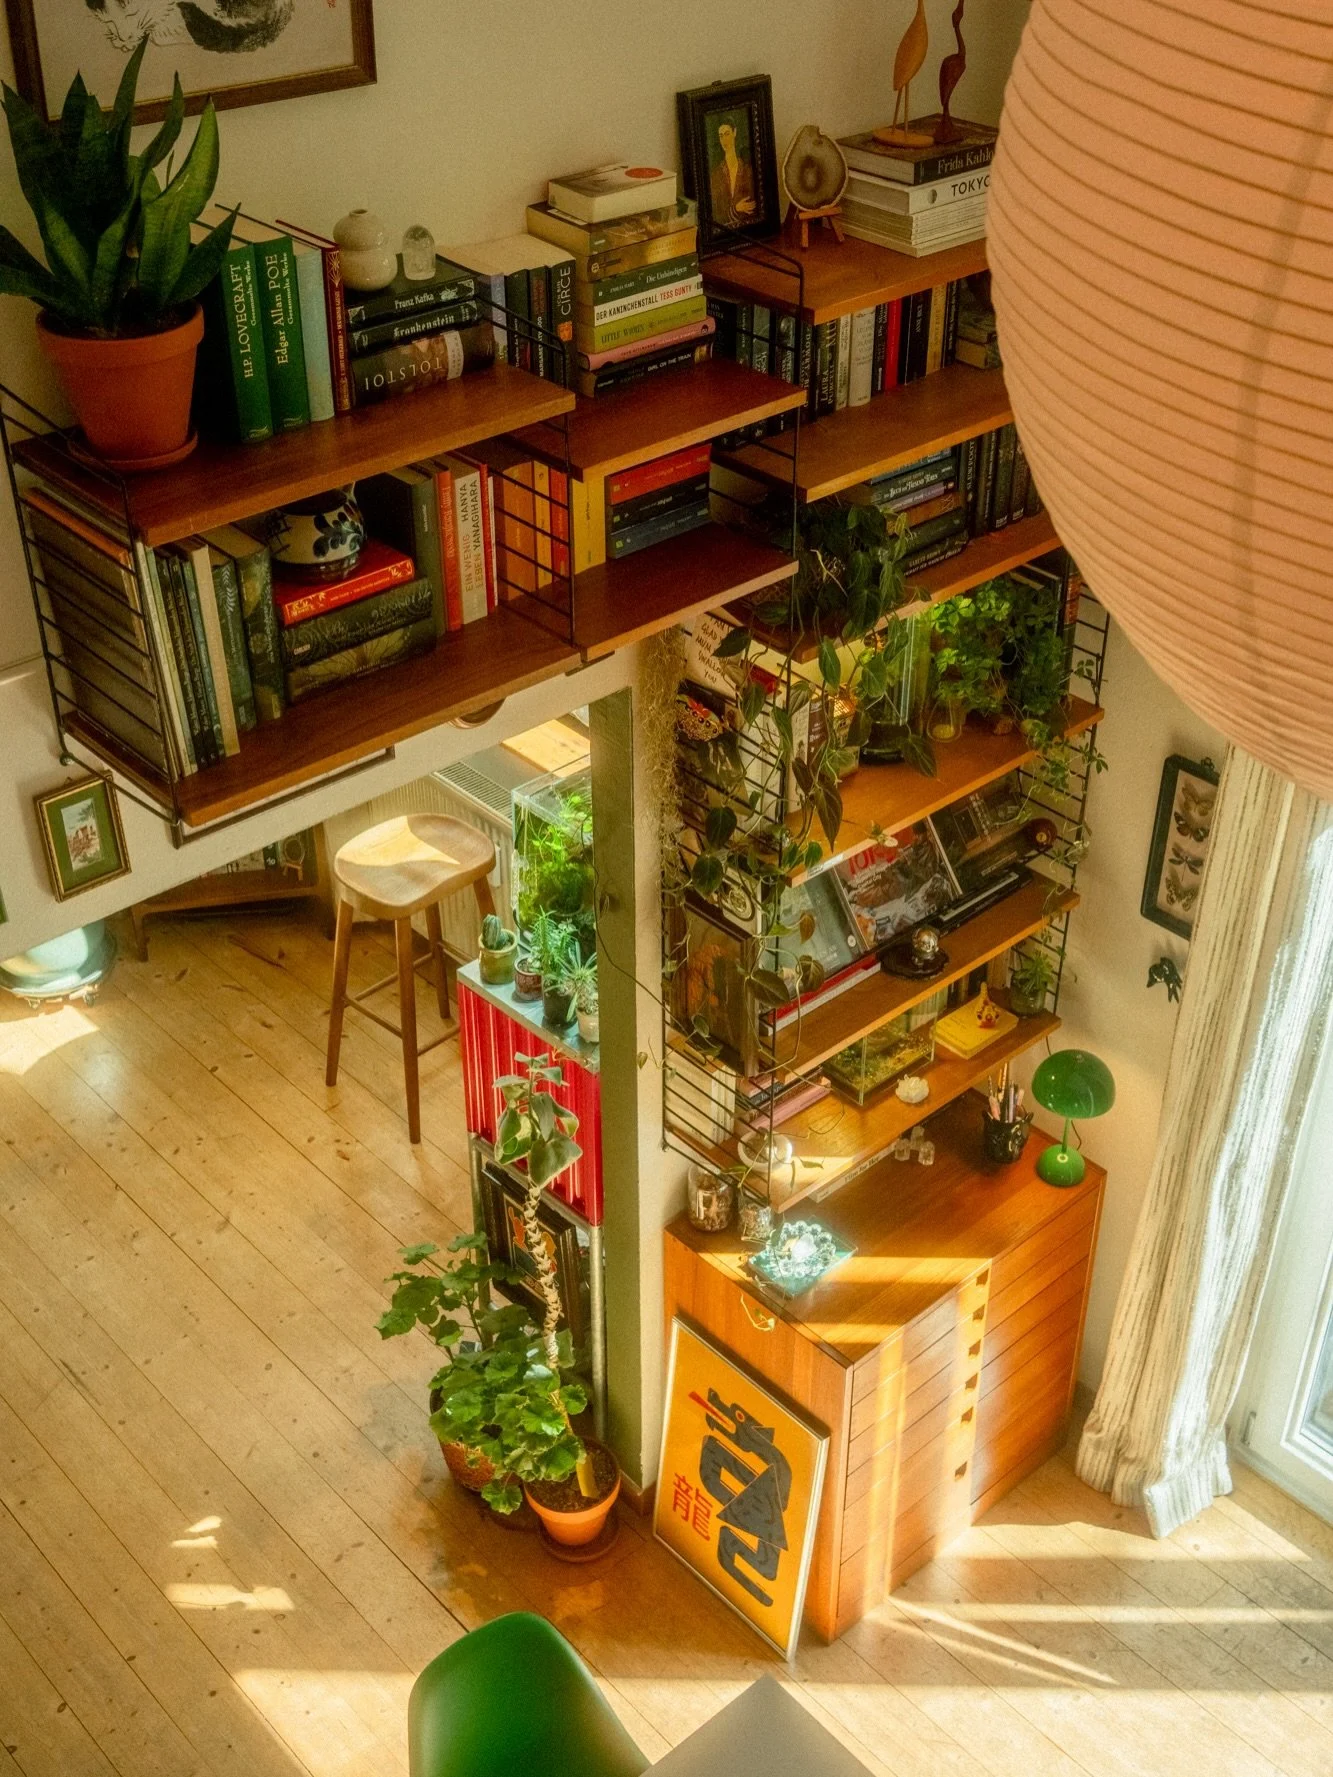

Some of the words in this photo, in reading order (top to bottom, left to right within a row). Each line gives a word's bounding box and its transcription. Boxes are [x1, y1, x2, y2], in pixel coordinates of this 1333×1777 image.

[938, 152, 964, 174] Frida
[266, 254, 280, 290] POE
[646, 273, 656, 284] Die
[395, 296, 414, 310] Franz
[415, 292, 434, 305] Kafka
[560, 266, 571, 314] CIRCE
[596, 309, 607, 321] DER
[608, 294, 659, 318] KANINCHENSTALL
[660, 289, 675, 301] TESS
[676, 284, 692, 298] GUNTY
[230, 264, 251, 354] LOVECRAFT
[271, 293, 285, 331] Allan
[393, 314, 455, 338] Frankenstein
[277, 334, 289, 365] Edgar
[668, 357, 677, 366] THE
[677, 353, 692, 363] TRAIN
[244, 356, 253, 378] H.P.
[365, 357, 443, 390] TOLSTOI
[459, 483, 468, 521] HANYA
[470, 479, 480, 550] YANAGIHARA
[465, 573, 473, 591] EIN
[474, 554, 482, 587] LEBEN
[700, 622, 718, 641] GLAD
[703, 669, 717, 683] YOU
